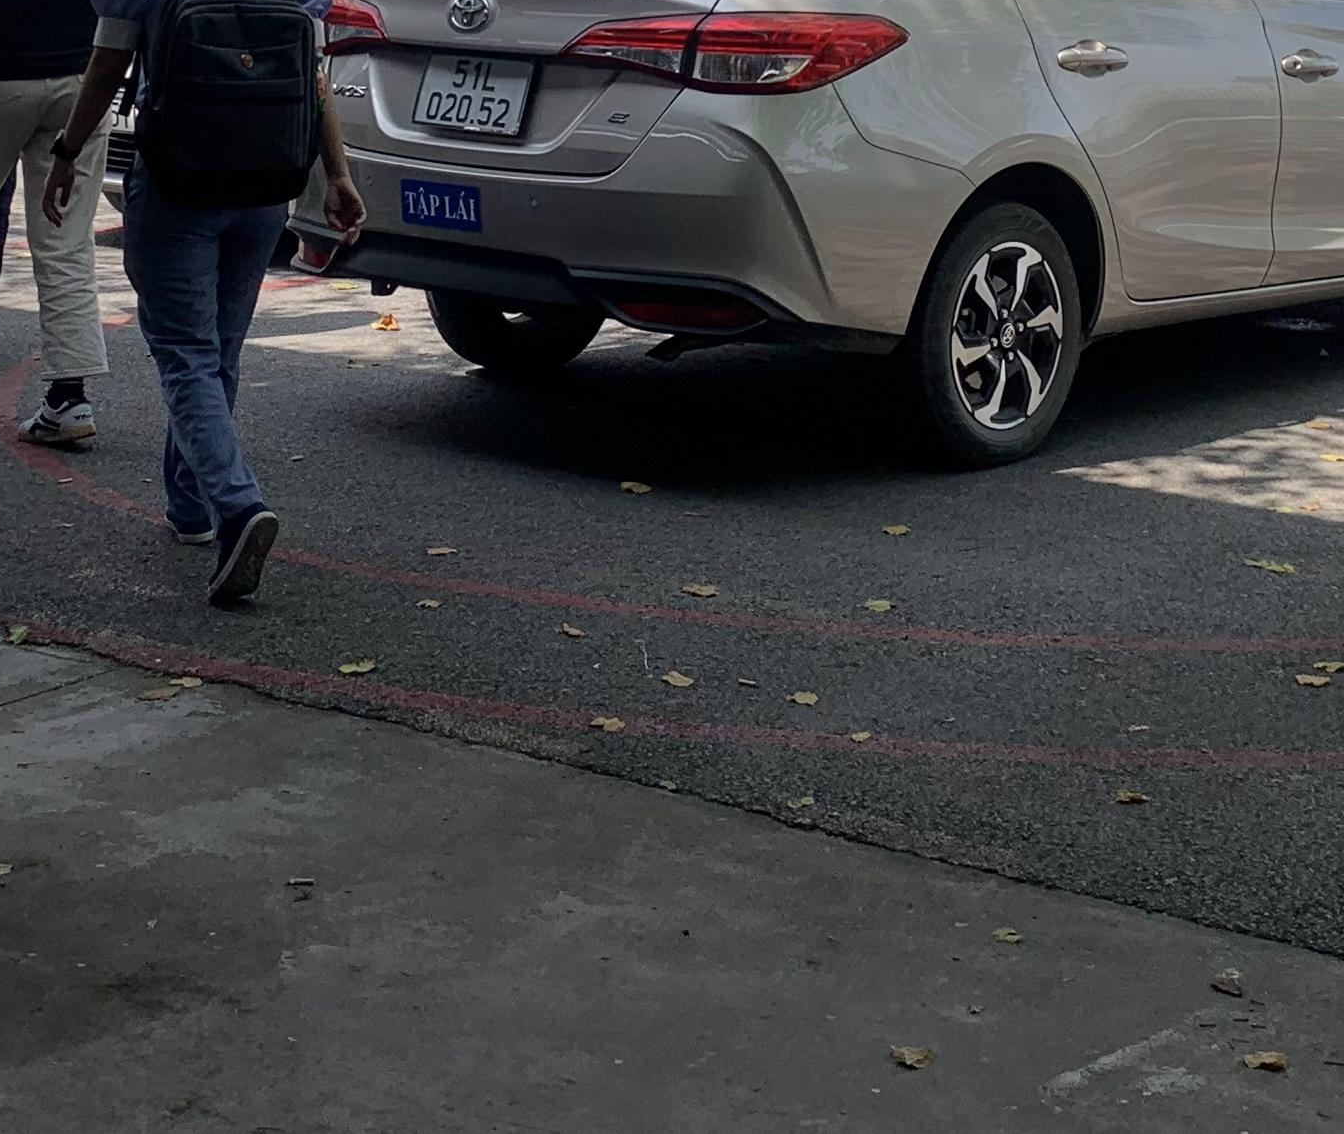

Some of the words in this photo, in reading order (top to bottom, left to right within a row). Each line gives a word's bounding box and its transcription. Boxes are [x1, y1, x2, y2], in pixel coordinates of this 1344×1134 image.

[452, 59, 495, 92] 51L
[426, 92, 510, 128] 020.52
[404, 186, 440, 220] TẬP
[444, 190, 476, 222] LÁI
